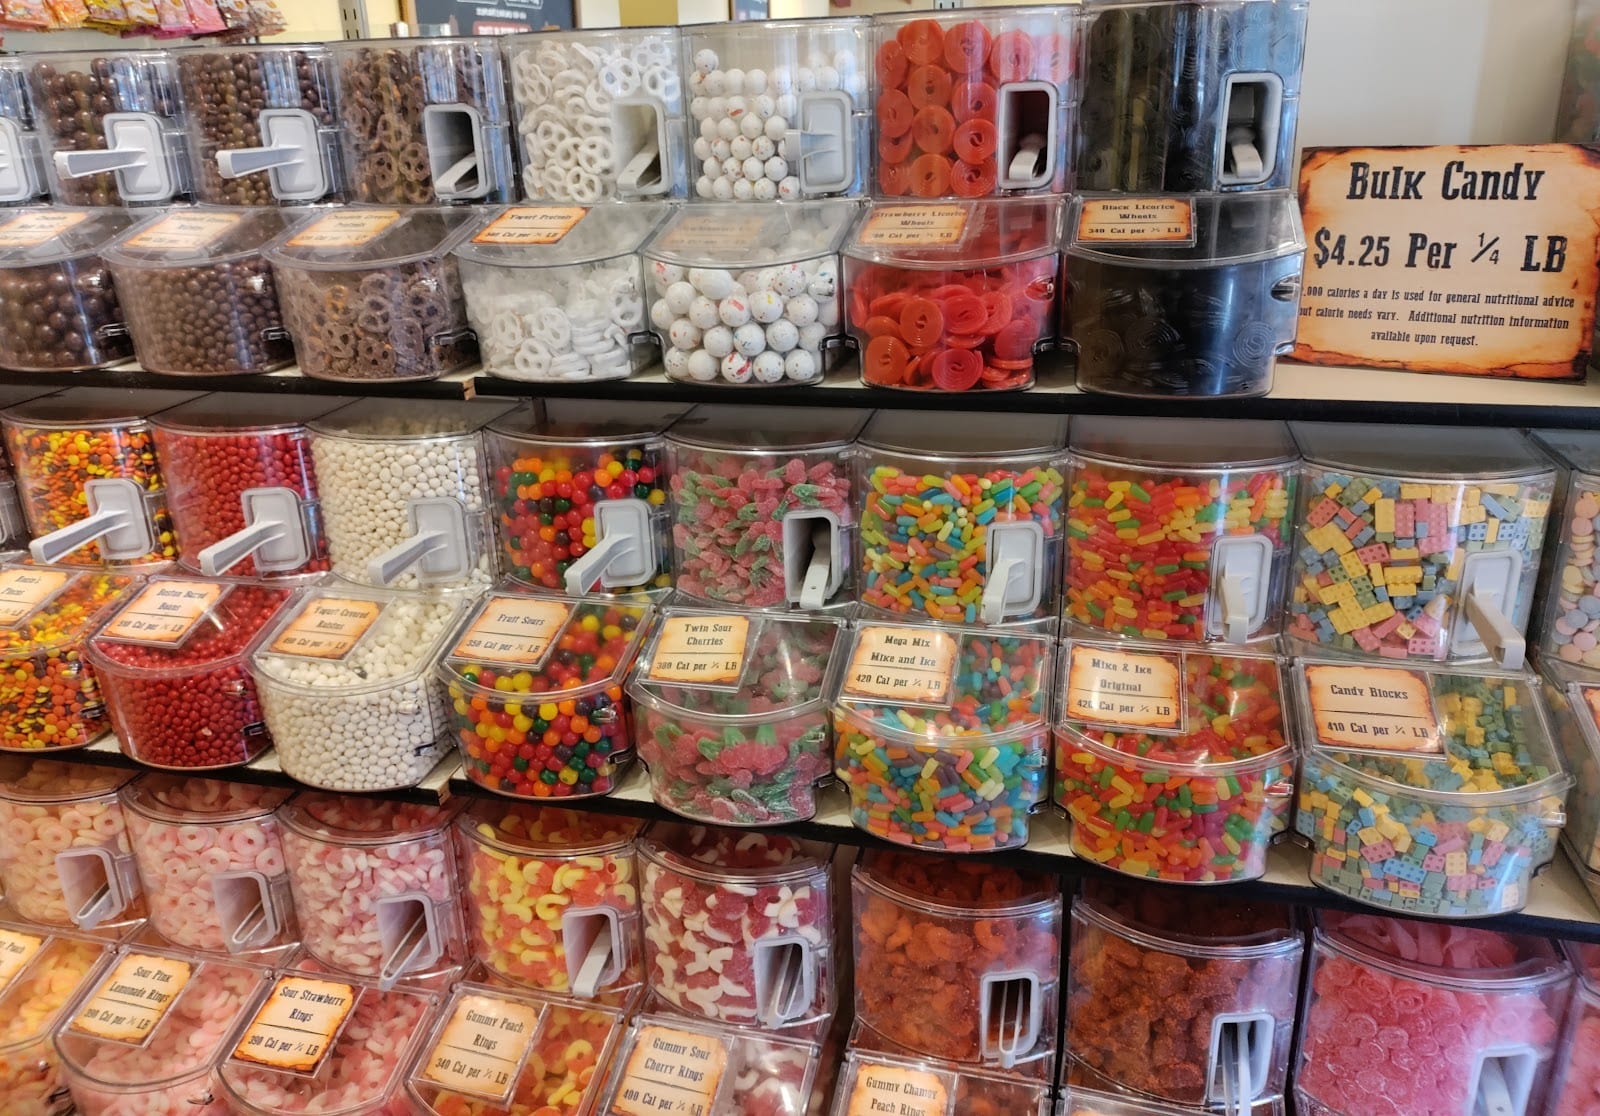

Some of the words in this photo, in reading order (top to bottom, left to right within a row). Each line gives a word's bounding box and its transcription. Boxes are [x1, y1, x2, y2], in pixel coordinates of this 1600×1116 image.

[1346, 161, 1426, 200] Bulk
[1441, 160, 1545, 201] Candy
[1314, 227, 1390, 269] $4.25
[1404, 233, 1457, 268] Per
[1520, 235, 1568, 272] LB
[1327, 288, 1360, 299] calories
[1372, 289, 1388, 300] day
[1392, 290, 1400, 300] is
[1404, 291, 1424, 301] used
[1428, 290, 1442, 302] for
[1446, 293, 1481, 304] general
[1485, 294, 1539, 306] nutritional
[1542, 296, 1575, 308] advice
[1316, 307, 1344, 318] calorie
[1348, 310, 1372, 319] needs
[1377, 310, 1399, 321] vary.
[1408, 310, 1456, 324] Additional
[1460, 314, 1505, 326] nutrition
[1509, 316, 1569, 329] information
[1371, 331, 1410, 342] available
[1414, 333, 1437, 345] upon
[1440, 335, 1478, 346] request.
[497, 613, 520, 623] Fruit
[521, 616, 545, 626] Sours
[685, 624, 709, 633] Twin
[712, 624, 733, 632] Sour
[484, 640, 497, 649] Cal
[498, 643, 513, 651] per
[527, 645, 541, 653] LB
[686, 636, 724, 646] Cherries
[885, 635, 907, 646] Mega
[912, 637, 930, 647] Mix
[676, 661, 690, 670] Cal
[693, 663, 707, 671] per
[725, 662, 737, 670] LB
[871, 652, 895, 663] Mike
[898, 656, 916, 665] and
[919, 657, 936, 666] Ike
[1092, 658, 1118, 670] Mike
[1122, 663, 1129, 672] &
[1135, 664, 1152, 674] Ike
[856, 674, 872, 683] 420
[876, 675, 890, 685] Cal
[893, 678, 909, 687] per
[927, 680, 941, 690] LB
[1100, 679, 1142, 692] Original
[1331, 684, 1364, 697] Candy
[1369, 687, 1409, 700] Blocks
[1099, 701, 1114, 711] Cal
[1119, 704, 1135, 713] per
[1156, 706, 1170, 716] LB
[1327, 721, 1345, 732] 410
[1350, 722, 1368, 734] Cal
[1372, 725, 1389, 736] per
[1411, 727, 1429, 738] LB
[133, 966, 152, 978] Sour
[152, 970, 173, 983] Pink
[146, 989, 171, 1004] Rings
[280, 986, 299, 999] Sour
[300, 990, 346, 1007] Strawberry
[99, 1010, 114, 1022] Cal
[288, 1008, 314, 1023] Rings
[466, 1009, 499, 1028] Gummy
[499, 1018, 525, 1034] Peach
[264, 1037, 280, 1049] Cal
[277, 1041, 293, 1052] per
[305, 1043, 320, 1056] LB
[472, 1033, 498, 1051] Rings
[652, 1037, 688, 1056] Gummy
[689, 1046, 711, 1061] Sour
[435, 1057, 452, 1070] 340
[452, 1060, 467, 1075] Cal
[466, 1066, 482, 1079] per
[495, 1071, 509, 1085] LB
[644, 1057, 675, 1075] Cherry
[678, 1065, 705, 1082] Rings
[866, 1076, 901, 1093] Gummy
[623, 1088, 640, 1101] 400
[642, 1092, 657, 1106] Cal
[658, 1098, 674, 1111] per
[690, 1102, 704, 1116] LB
[870, 1097, 897, 1114] Peach
[900, 1103, 927, 1116] Rings
